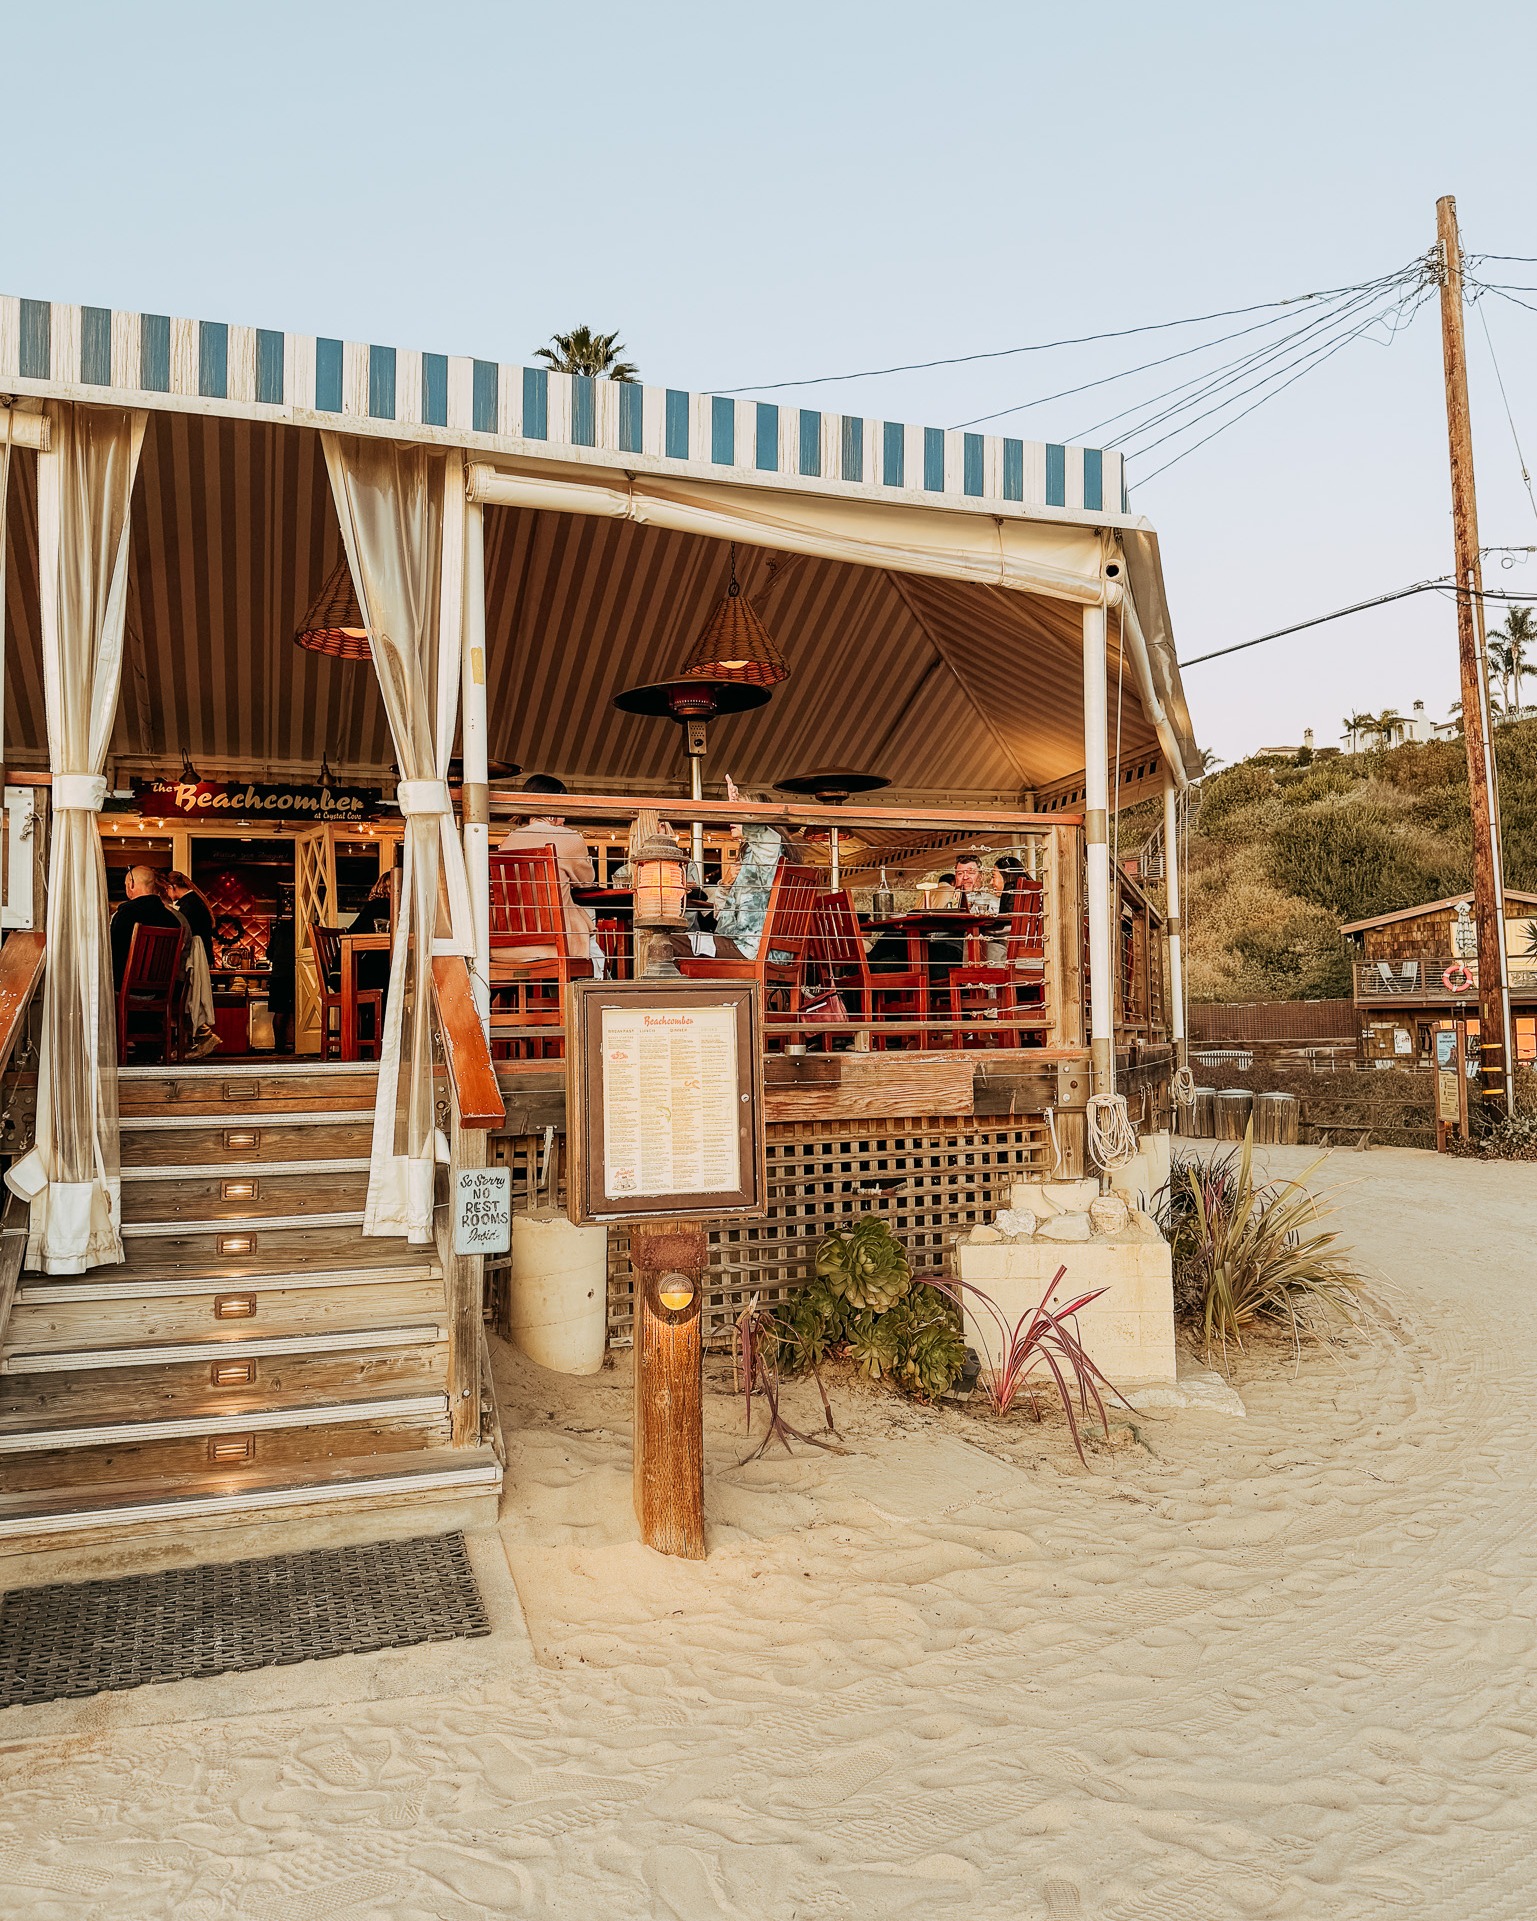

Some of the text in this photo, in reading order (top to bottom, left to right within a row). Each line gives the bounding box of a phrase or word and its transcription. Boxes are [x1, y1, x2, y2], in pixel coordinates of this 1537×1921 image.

[150, 782, 364, 812] The Beachcomber
[322, 811, 346, 821] Crystal
[346, 811, 362, 820] Cove
[643, 1015, 694, 1027] Beachcomber
[460, 1174, 505, 1189] So Sorry
[473, 1188, 490, 1199] NO
[465, 1201, 500, 1214] REST
[461, 1212, 508, 1228] ROOMS
